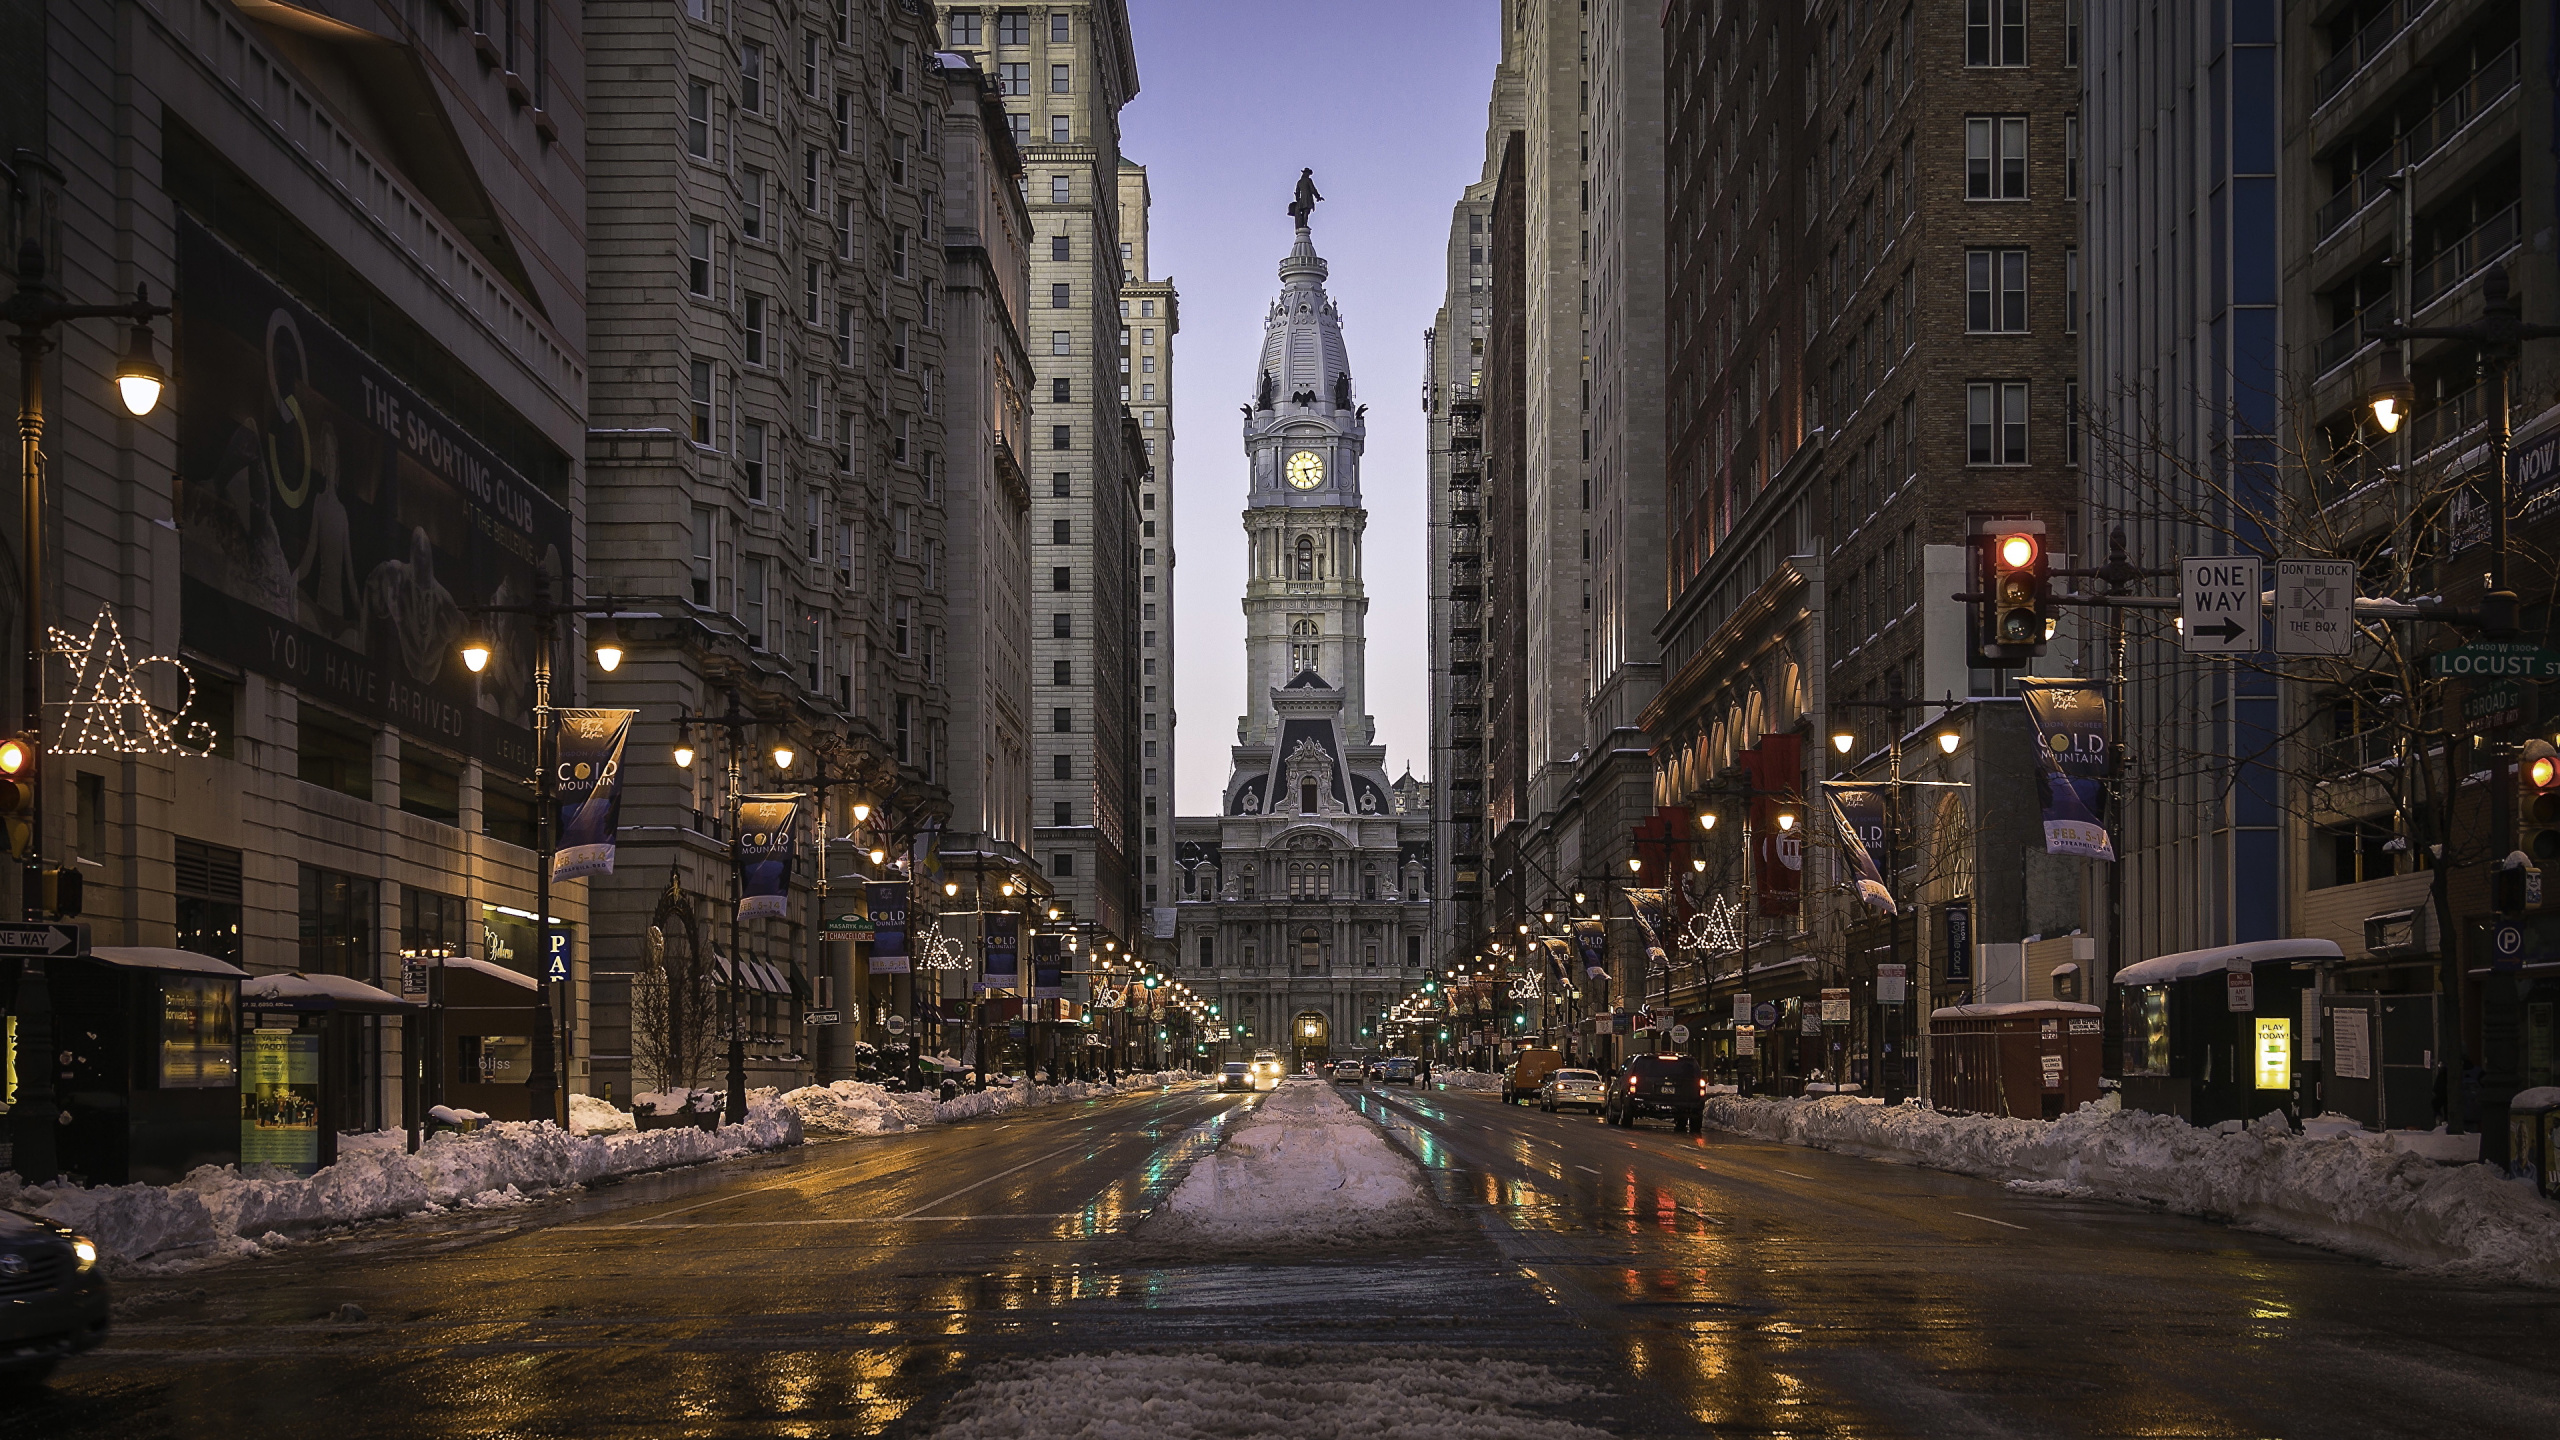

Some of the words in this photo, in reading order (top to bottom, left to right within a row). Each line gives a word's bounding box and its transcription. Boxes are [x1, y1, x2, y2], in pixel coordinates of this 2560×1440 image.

[361, 375, 400, 439] THE
[407, 410, 491, 504] SPORTING
[496, 479, 533, 534] CLUB
[2518, 439, 2556, 486] NOW
[2197, 566, 2244, 586] ONE
[2314, 565, 2348, 576] BLOCK
[2195, 591, 2247, 612] WAY
[2290, 621, 2310, 632] THE
[2315, 621, 2337, 632] BOX
[2498, 643, 2508, 653] W
[2441, 655, 2535, 674] LOCUST
[2545, 662, 2560, 675] ST
[268, 626, 311, 676] YOU
[326, 652, 376, 703] HAVE
[388, 680, 463, 738] ARRIVED
[2472, 691, 2507, 716] BROAD
[2509, 692, 2519, 706] ST
[496, 735, 526, 766] LEVEL
[2037, 733, 2104, 754] COLD
[558, 777, 615, 791] MOUNAIN
[2053, 828, 2080, 841] FEB.
[870, 910, 906, 922] COLD
[20, 931, 48, 946] WAY
[829, 932, 866, 940] CHANCELLOR
[987, 935, 1016, 945] COLD
[1952, 921, 1962, 950] royale
[1035, 954, 1061, 962] COLD
[1953, 951, 1962, 975] court
[404, 972, 413, 980] 27
[2261, 1023, 2284, 1031] PLAY
[2258, 1032, 2289, 1040] TODAY!
[478, 1057, 511, 1070] bliss
